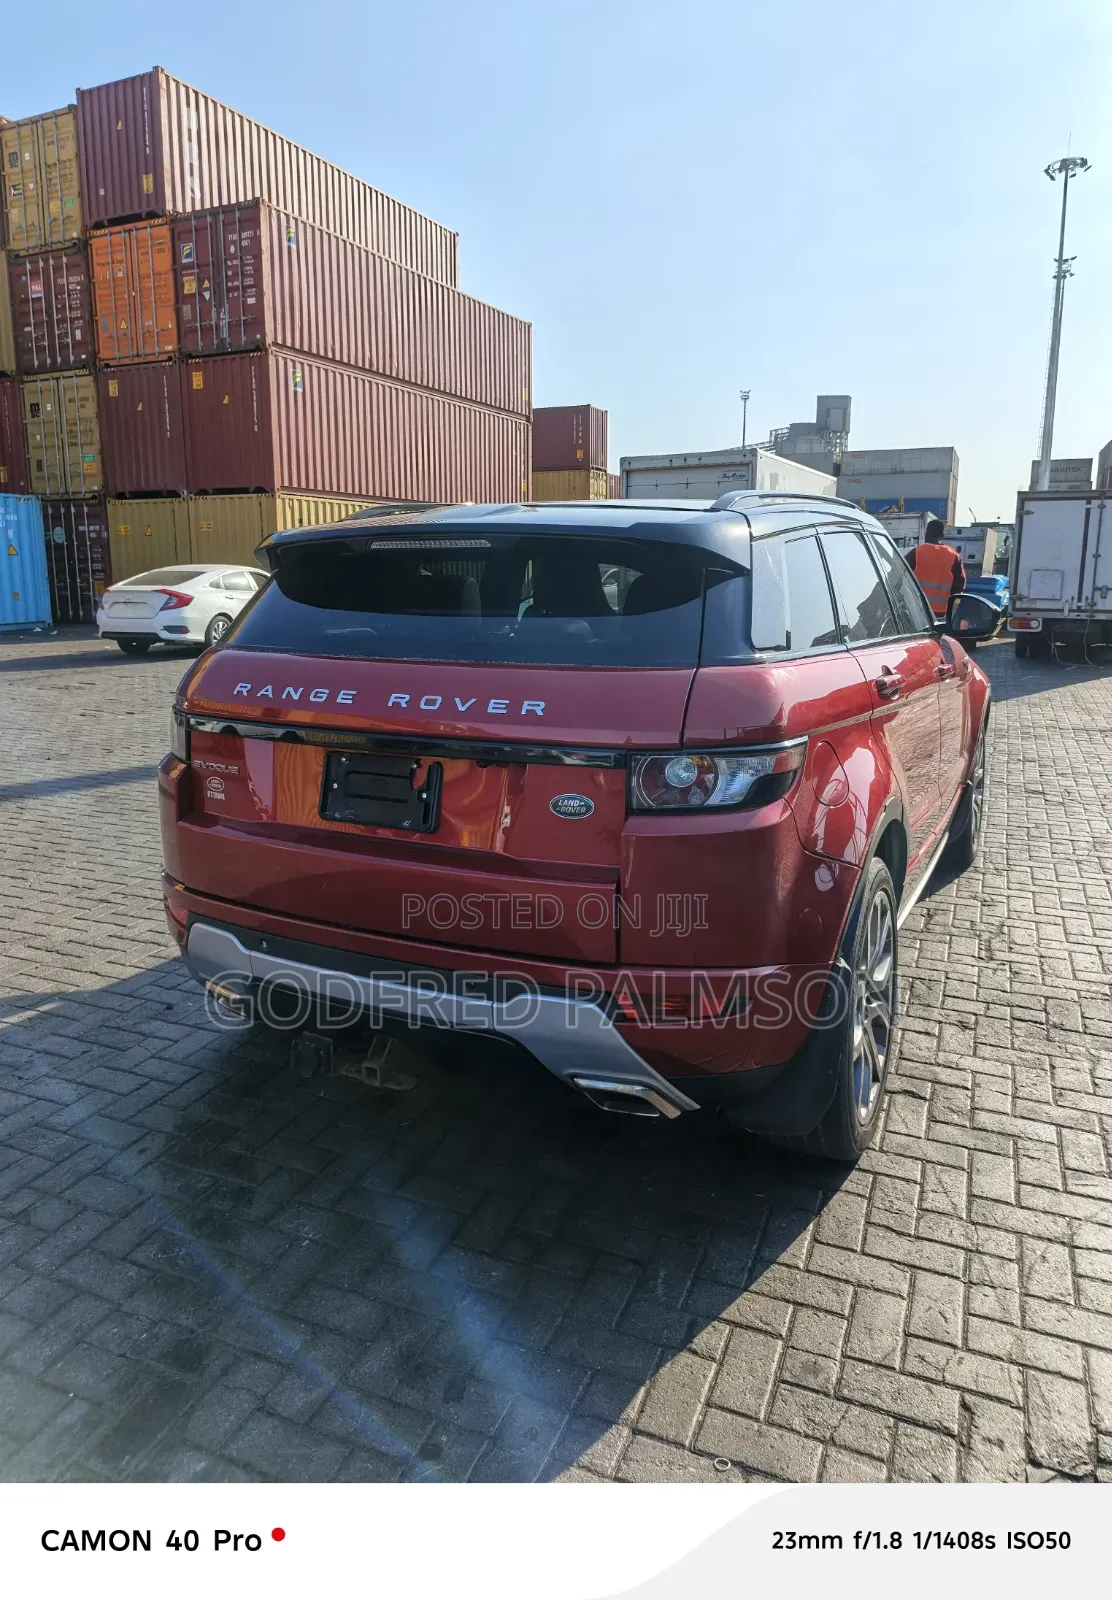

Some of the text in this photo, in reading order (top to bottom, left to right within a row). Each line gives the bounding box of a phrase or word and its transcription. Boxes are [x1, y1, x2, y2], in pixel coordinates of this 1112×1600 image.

[233, 682, 546, 716] RANGE ROVER
[193, 760, 239, 774] EVOQUE
